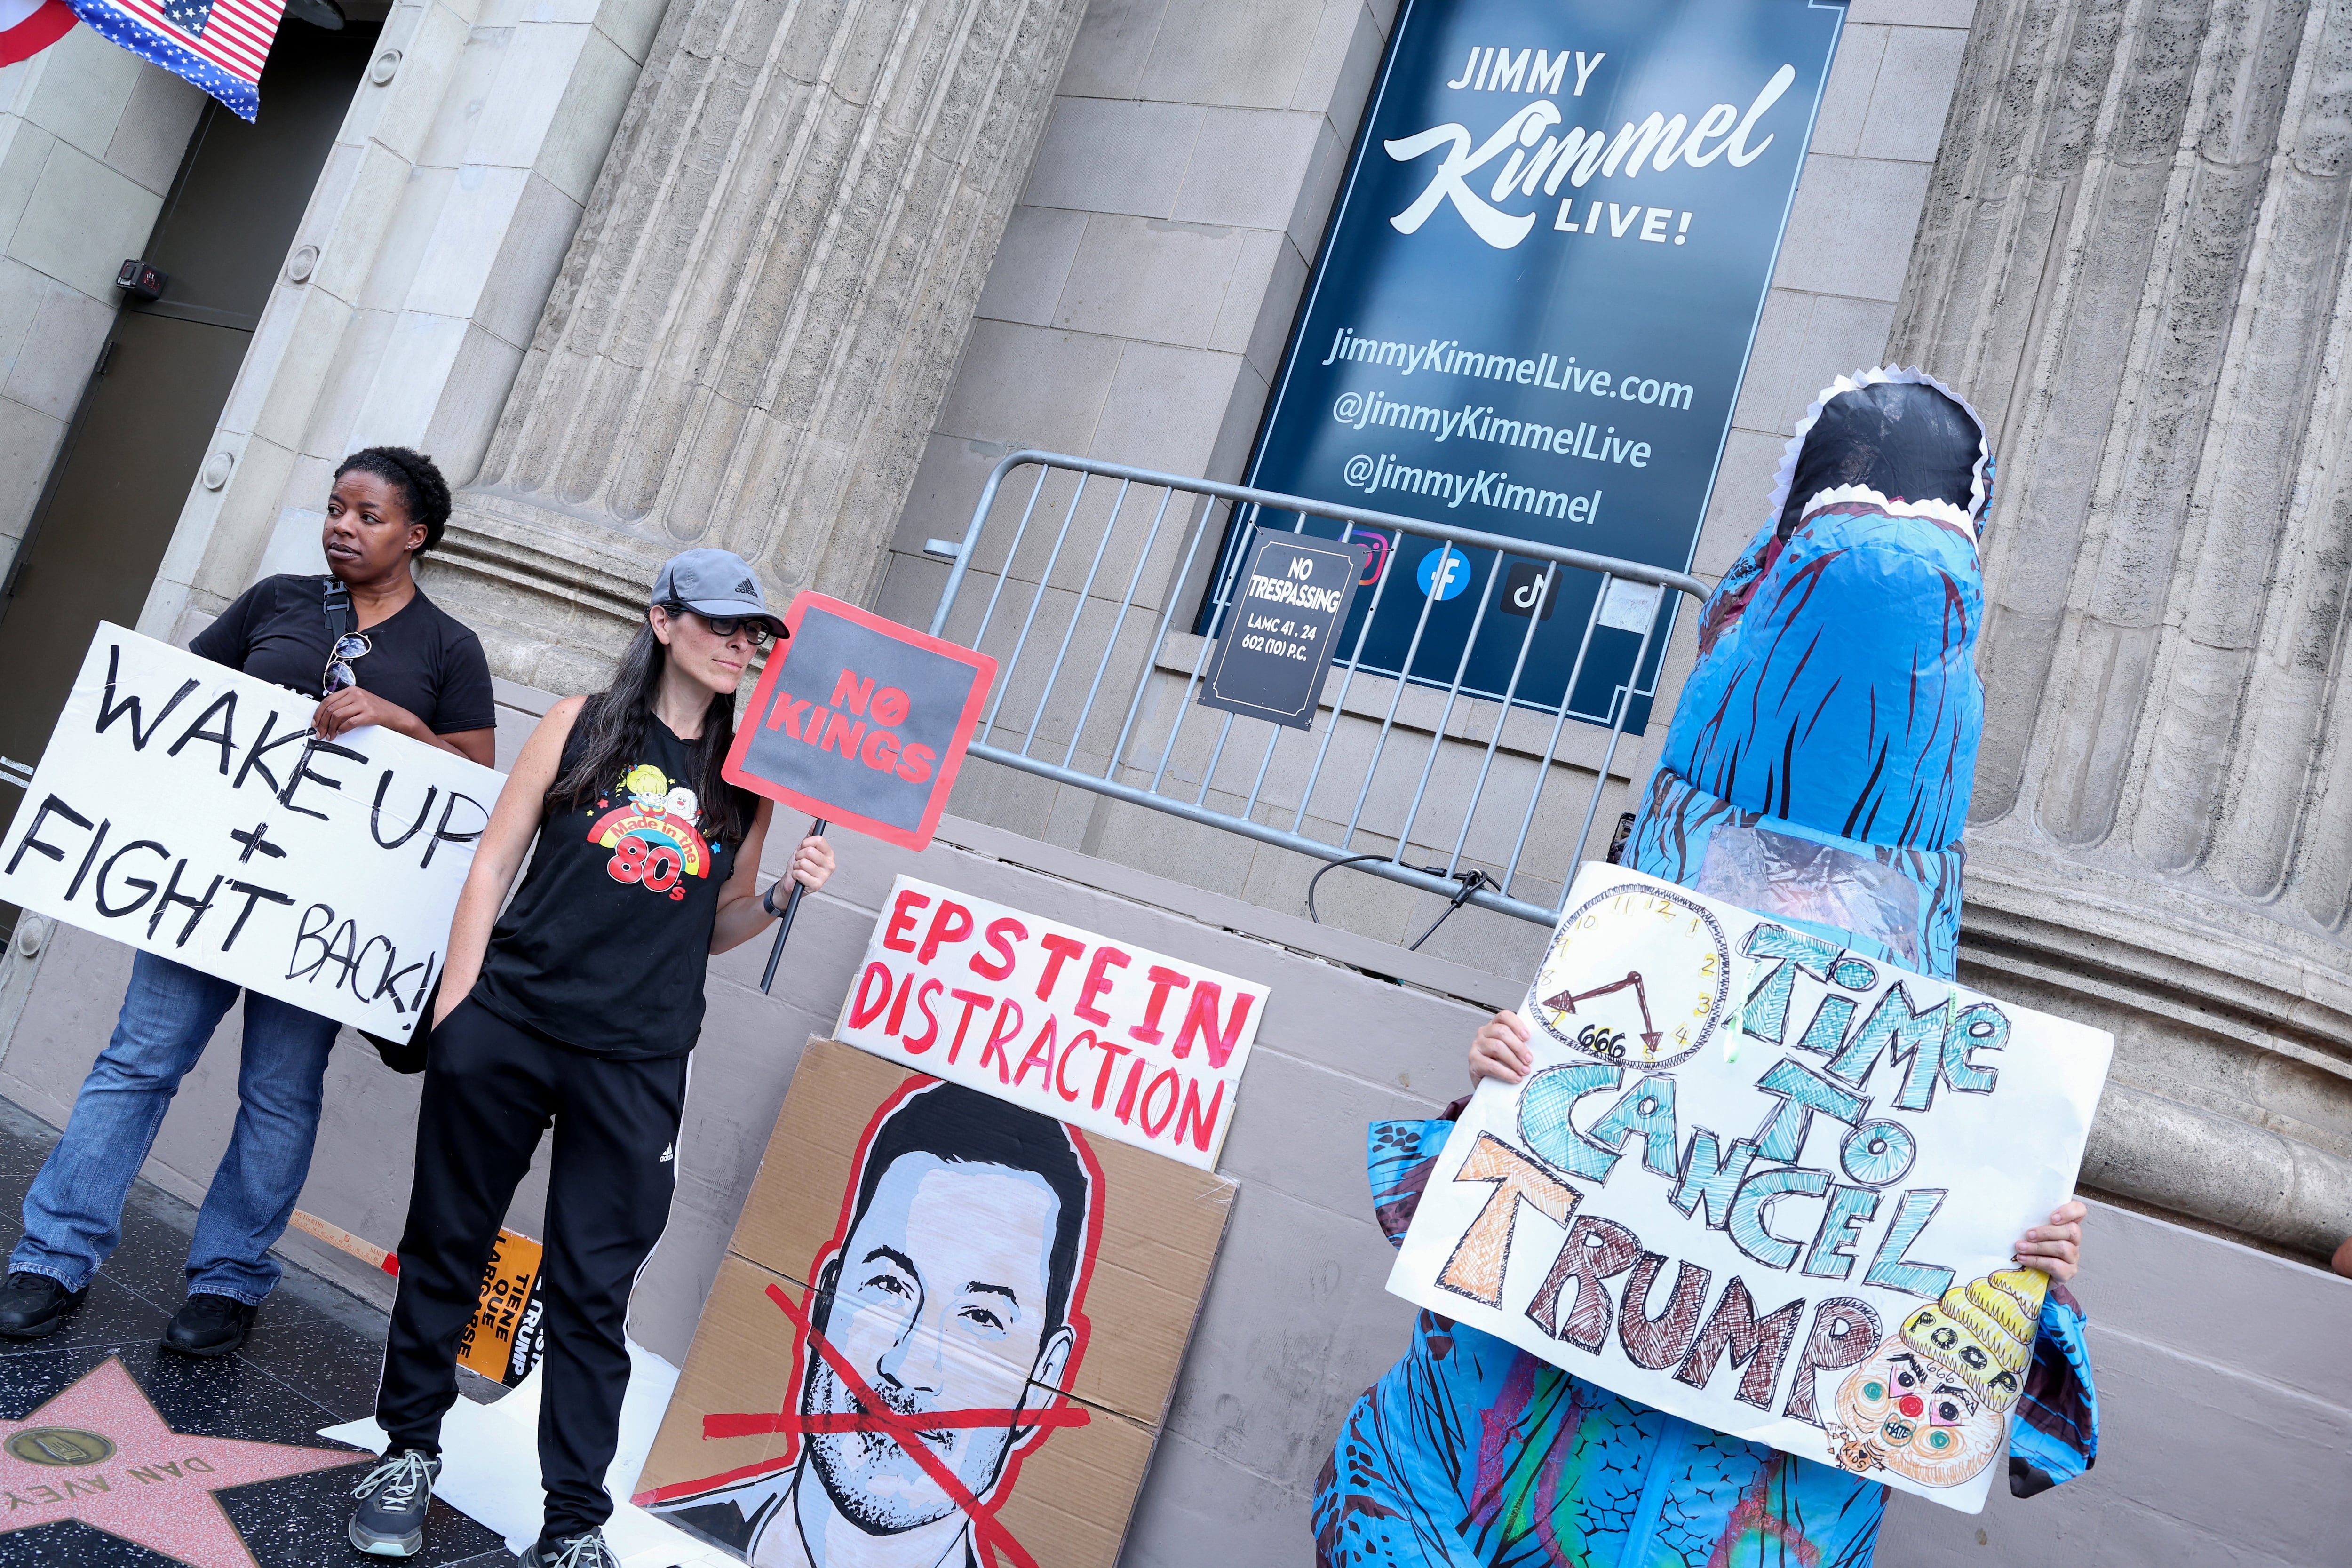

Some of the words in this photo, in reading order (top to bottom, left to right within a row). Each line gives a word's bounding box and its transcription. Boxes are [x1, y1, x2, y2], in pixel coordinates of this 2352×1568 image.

[1447, 46, 1605, 96] JIMMY
[1383, 63, 1796, 249] Kimmel
[1552, 198, 1693, 246] LIVE!
[1322, 328, 1694, 411] JimmyKimmelLive.com
[1333, 391, 1652, 468] @JimmyKimmelLive
[1343, 454, 1602, 525] @JimmyKimmel
[1248, 574, 1341, 613] TRESPASSING
[1287, 556, 1313, 581] NO
[1242, 634, 1264, 652] 602
[1265, 637, 1287, 657] (10)
[1287, 643, 1307, 661] P.C.
[1247, 613, 1280, 633] LAMC
[830, 668, 910, 727] NO
[96, 645, 368, 821] WAKE
[371, 769, 490, 869] UP
[766, 691, 937, 784] KINGS
[16, 764, 29, 772] CLEAR
[610, 817, 658, 838] Made
[661, 823, 677, 837] in
[678, 836, 696, 864] the
[607, 835, 687, 901] 80's
[4, 793, 296, 951] FIGHT
[285, 904, 436, 1032] BACK!
[883, 889, 1256, 1069] EPSTEIN
[848, 962, 1224, 1153] DISTRACTION
[1577, 1024, 1626, 1058] 666
[1746, 1057, 1918, 1186] TO
[1516, 1062, 1956, 1301] CANCEL
[369, 1247, 387, 1259] AINTS
[481, 1279, 509, 1329] QUE
[1433, 1131, 1883, 1431] TRUMP
[495, 1274, 530, 1343] TIENE
[1909, 1311, 2018, 1393] POOP
[1927, 1361, 1954, 1384] 666
[1843, 1446, 1866, 1468] KIDS
[1884, 1421, 1911, 1441] HATE
[4, 1475, 111, 1510] AVEY
[127, 1457, 215, 1484] DAN
